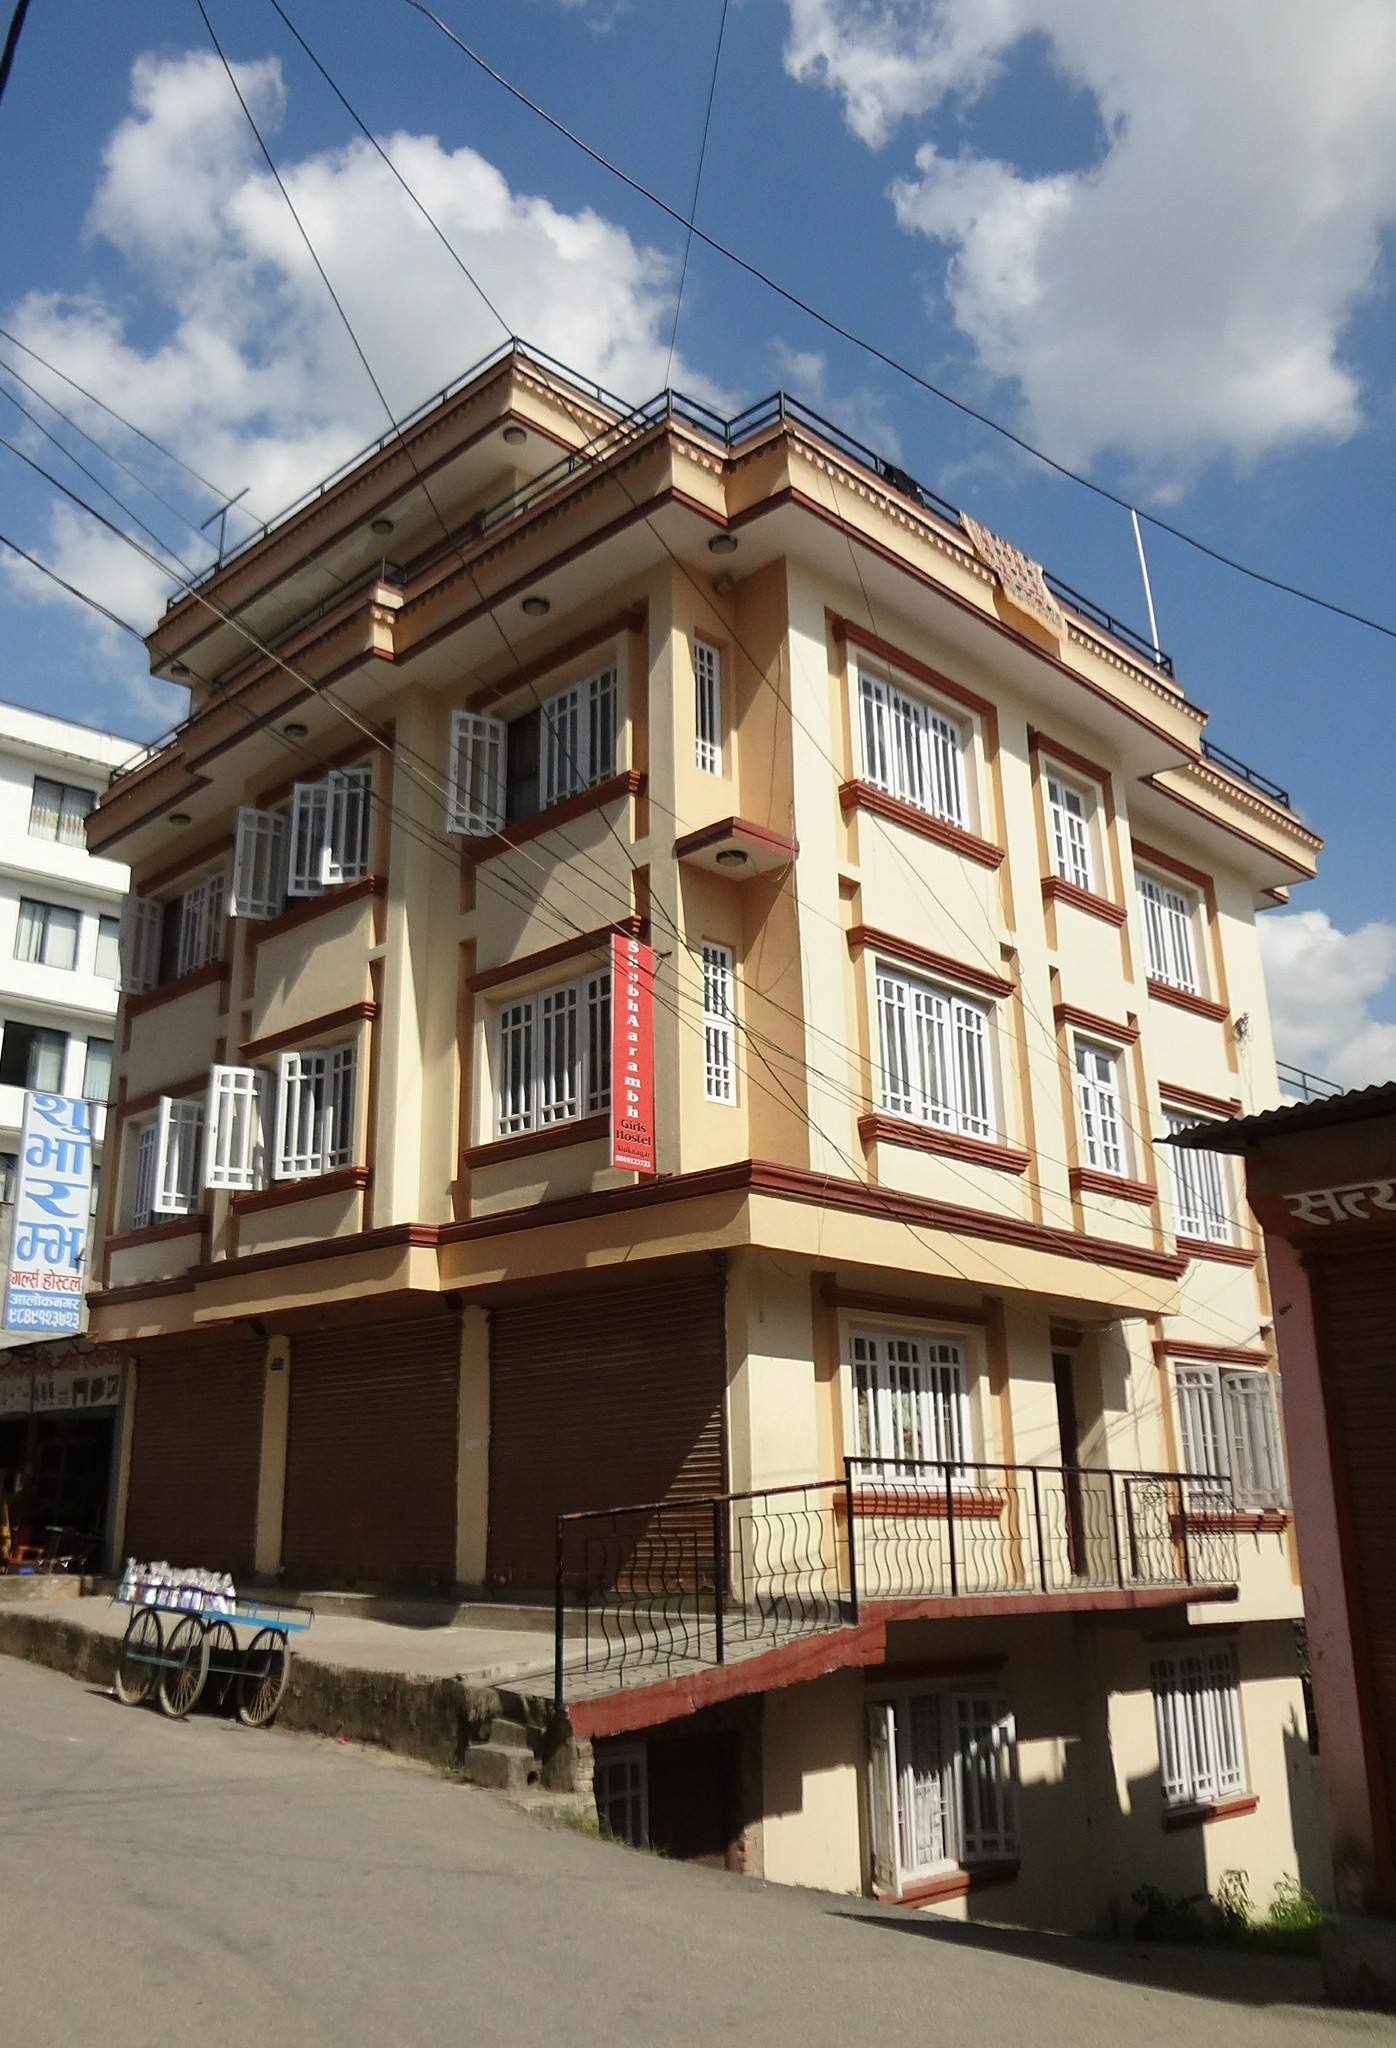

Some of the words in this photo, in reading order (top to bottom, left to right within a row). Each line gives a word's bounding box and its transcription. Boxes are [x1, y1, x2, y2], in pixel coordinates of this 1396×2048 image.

[620, 1119, 647, 1133] Girls
[616, 1130, 651, 1146] Hostel
[43, 1268, 82, 1292] होस्टल
